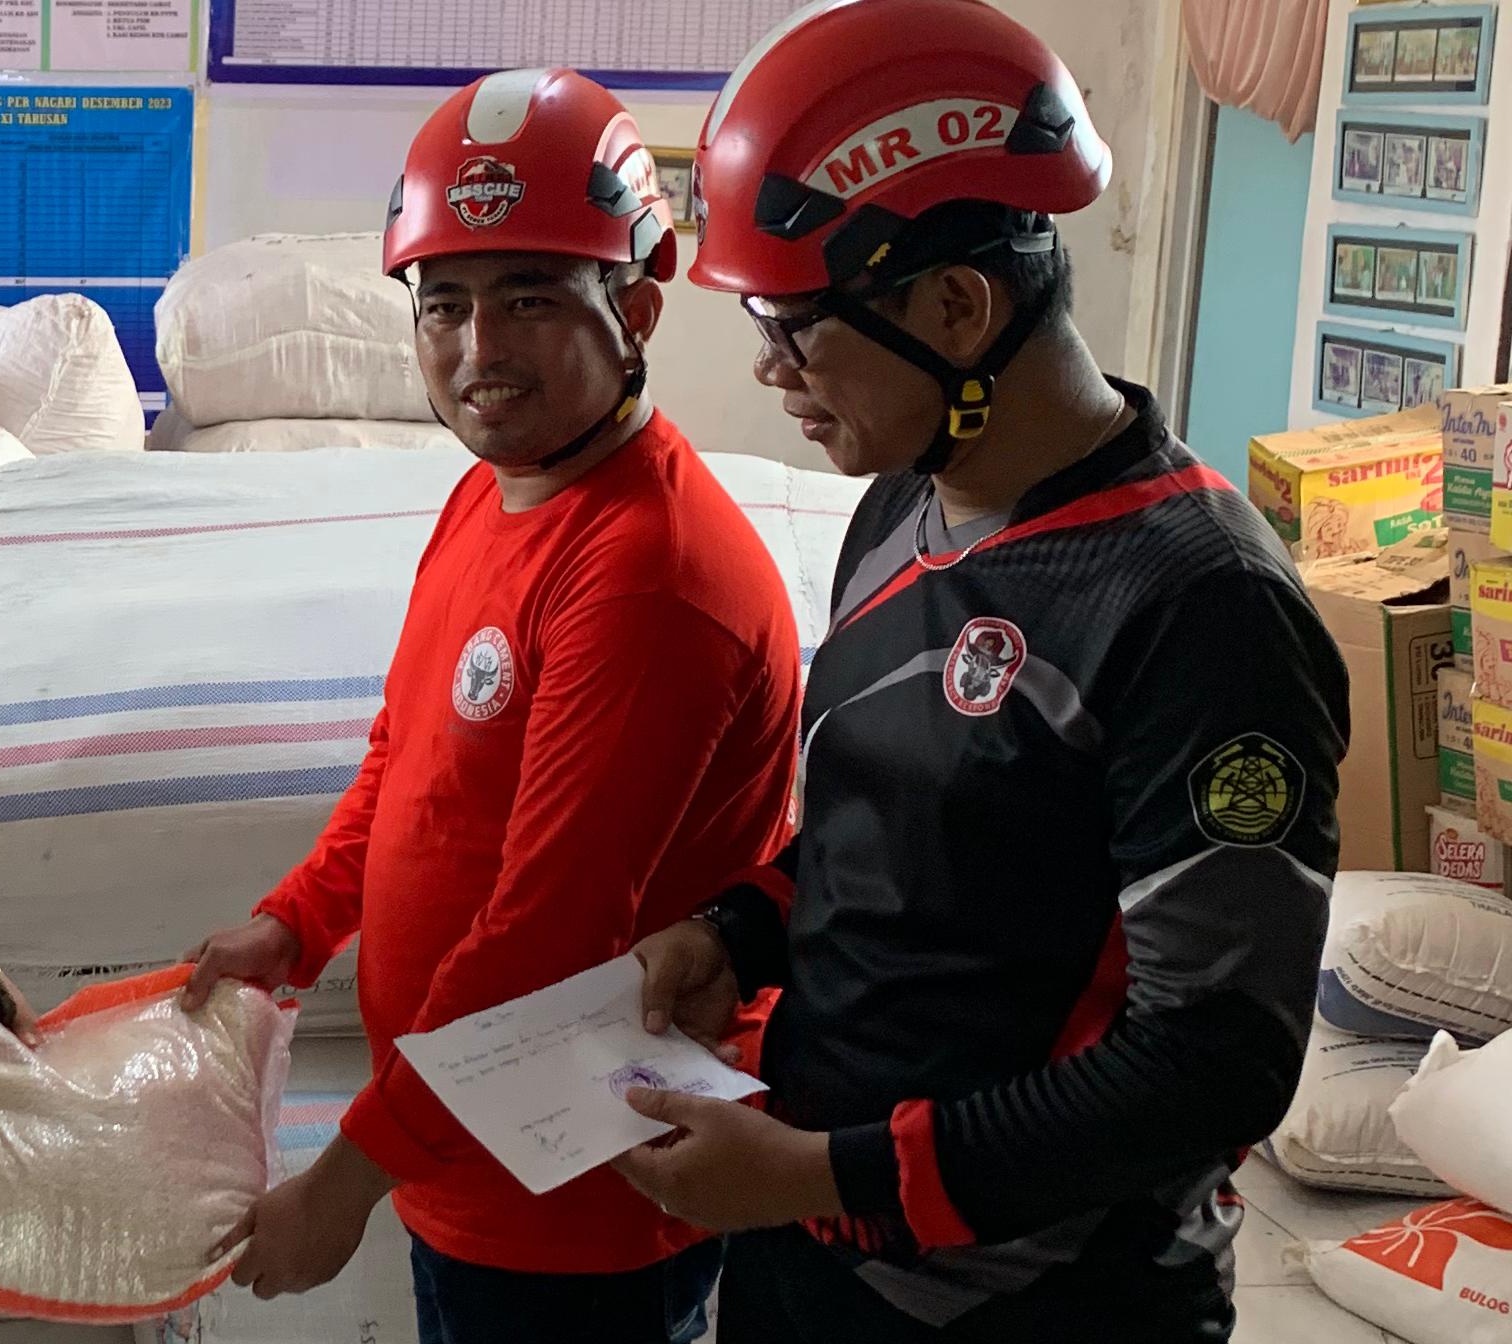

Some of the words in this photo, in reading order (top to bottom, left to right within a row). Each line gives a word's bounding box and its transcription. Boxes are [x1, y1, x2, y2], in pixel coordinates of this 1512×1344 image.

[7, 96, 29, 109] PER
[34, 96, 77, 109] NAGARI
[82, 97, 143, 110] DESEMBER
[148, 97, 172, 110] 2023
[0, 112, 13, 125] XI
[17, 112, 68, 125] TARUSAN
[825, 127, 921, 193] MR
[937, 105, 1005, 146] 02
[449, 183, 522, 202] RESCUE
[1460, 448, 1477, 463] 40
[1407, 514, 1444, 534] SOT
[1437, 834, 1486, 862] SELERA
[1458, 1287, 1510, 1314] BULOG
